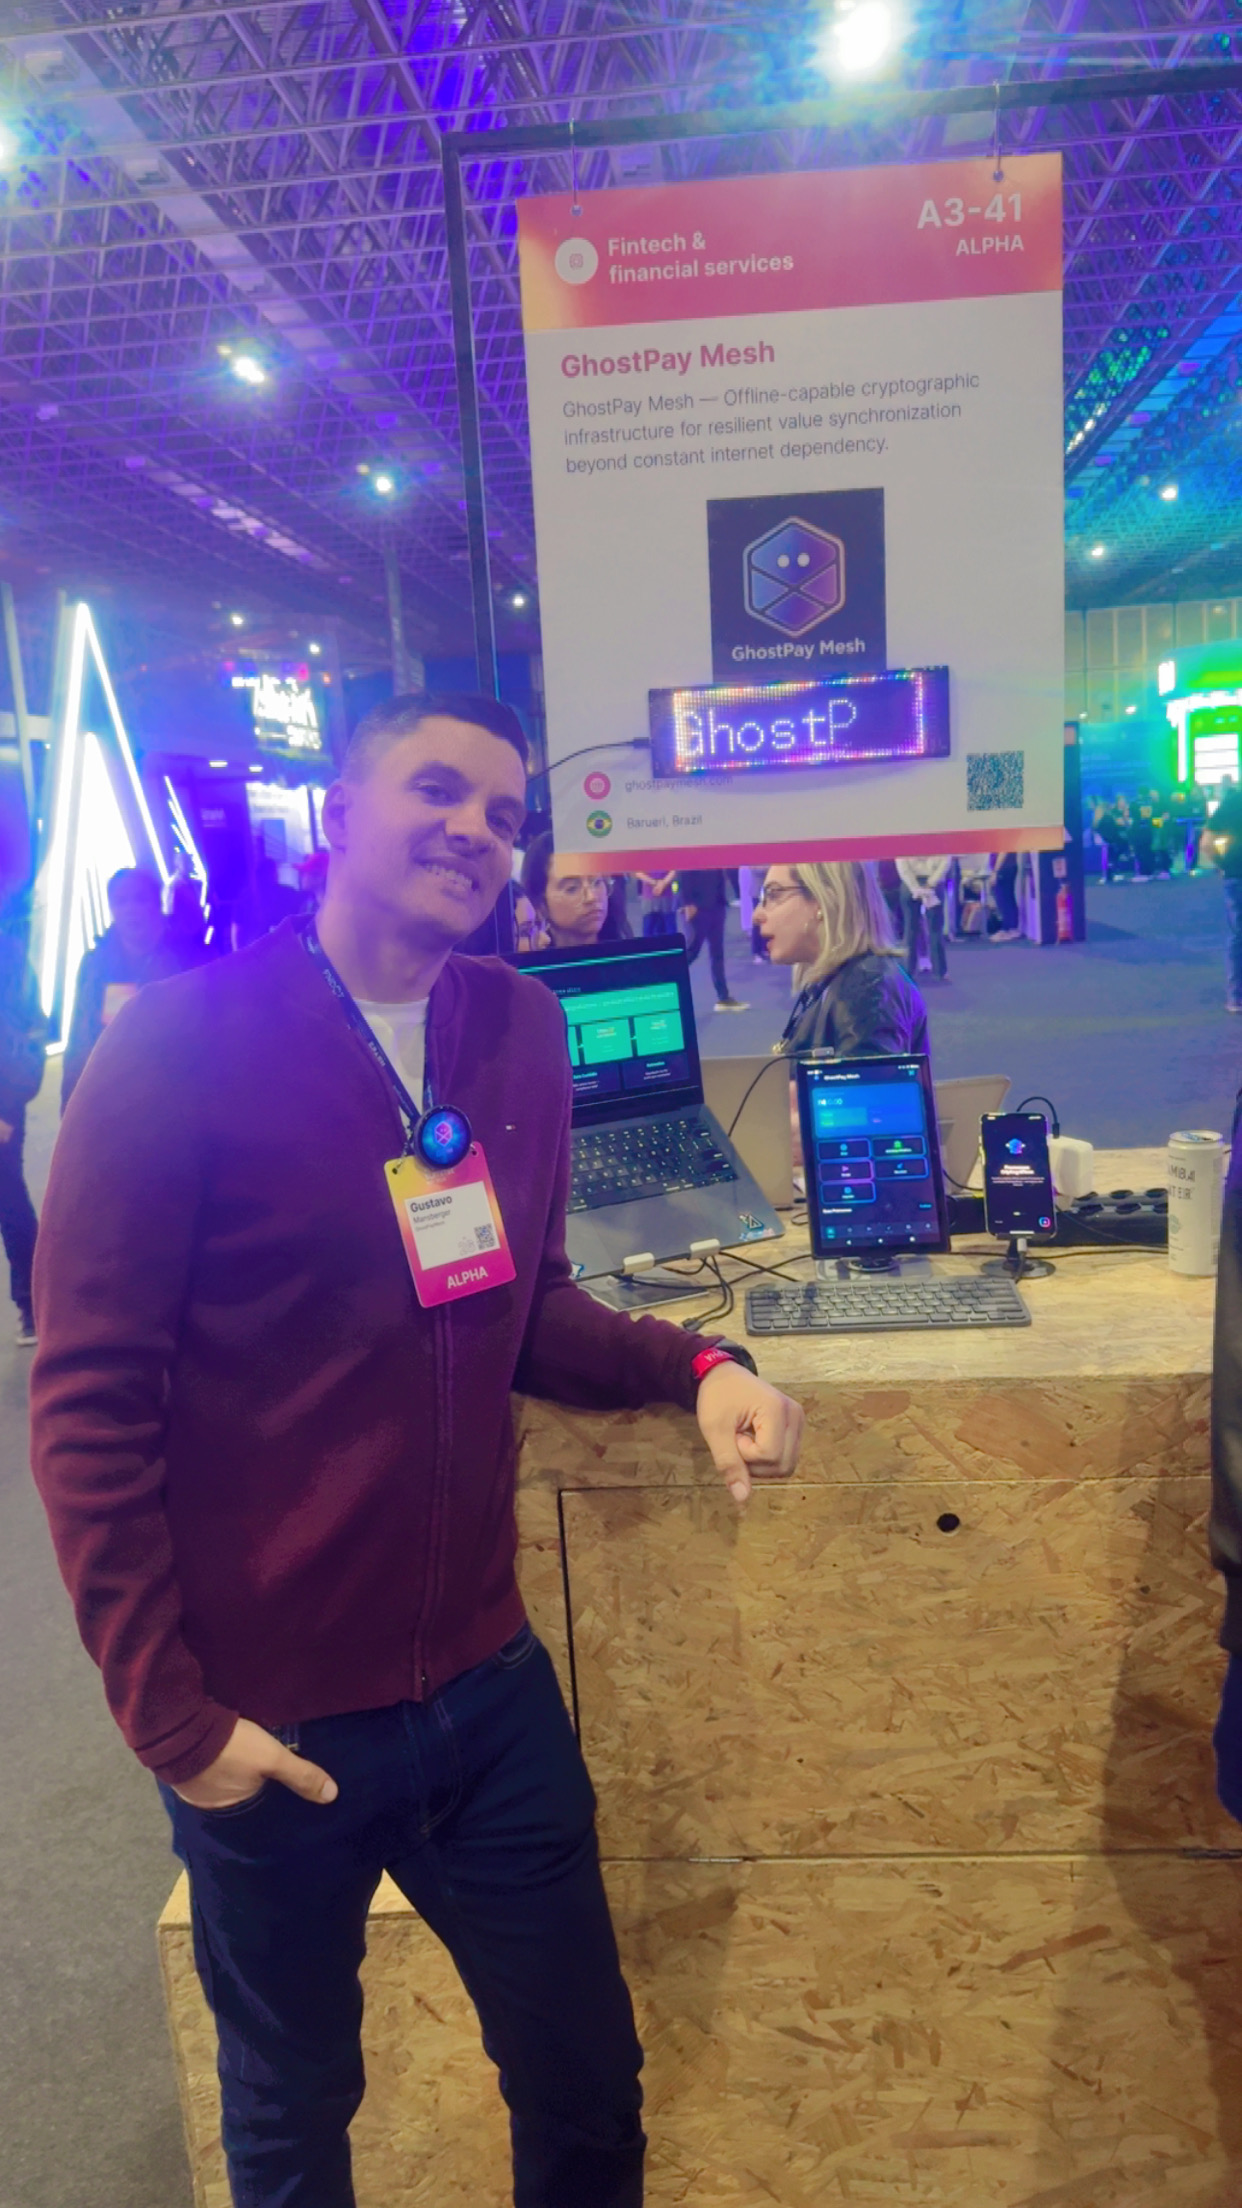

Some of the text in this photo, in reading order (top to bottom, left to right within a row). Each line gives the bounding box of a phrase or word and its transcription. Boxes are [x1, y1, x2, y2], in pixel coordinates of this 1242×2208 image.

[917, 192, 1022, 229] A3-41
[608, 231, 706, 257] Fintech &
[956, 234, 1024, 256] ALPHA
[609, 254, 794, 284] financial services
[561, 341, 775, 378] GhostPay Mesh
[563, 398, 642, 418] GhostPay
[649, 394, 694, 412] Mesh
[724, 382, 855, 407] Offline-capable
[861, 373, 980, 399] cryptographic
[564, 403, 961, 446] infrastructure for resilient value synchronization
[566, 437, 888, 475] beyond constant internet dependency.
[731, 638, 866, 661] GhostPay Mesh
[679, 698, 857, 757] GhostP
[672, 814, 702, 827] Brazil
[410, 1195, 453, 1213] Gustavo
[447, 1266, 489, 1289] ALPHA
